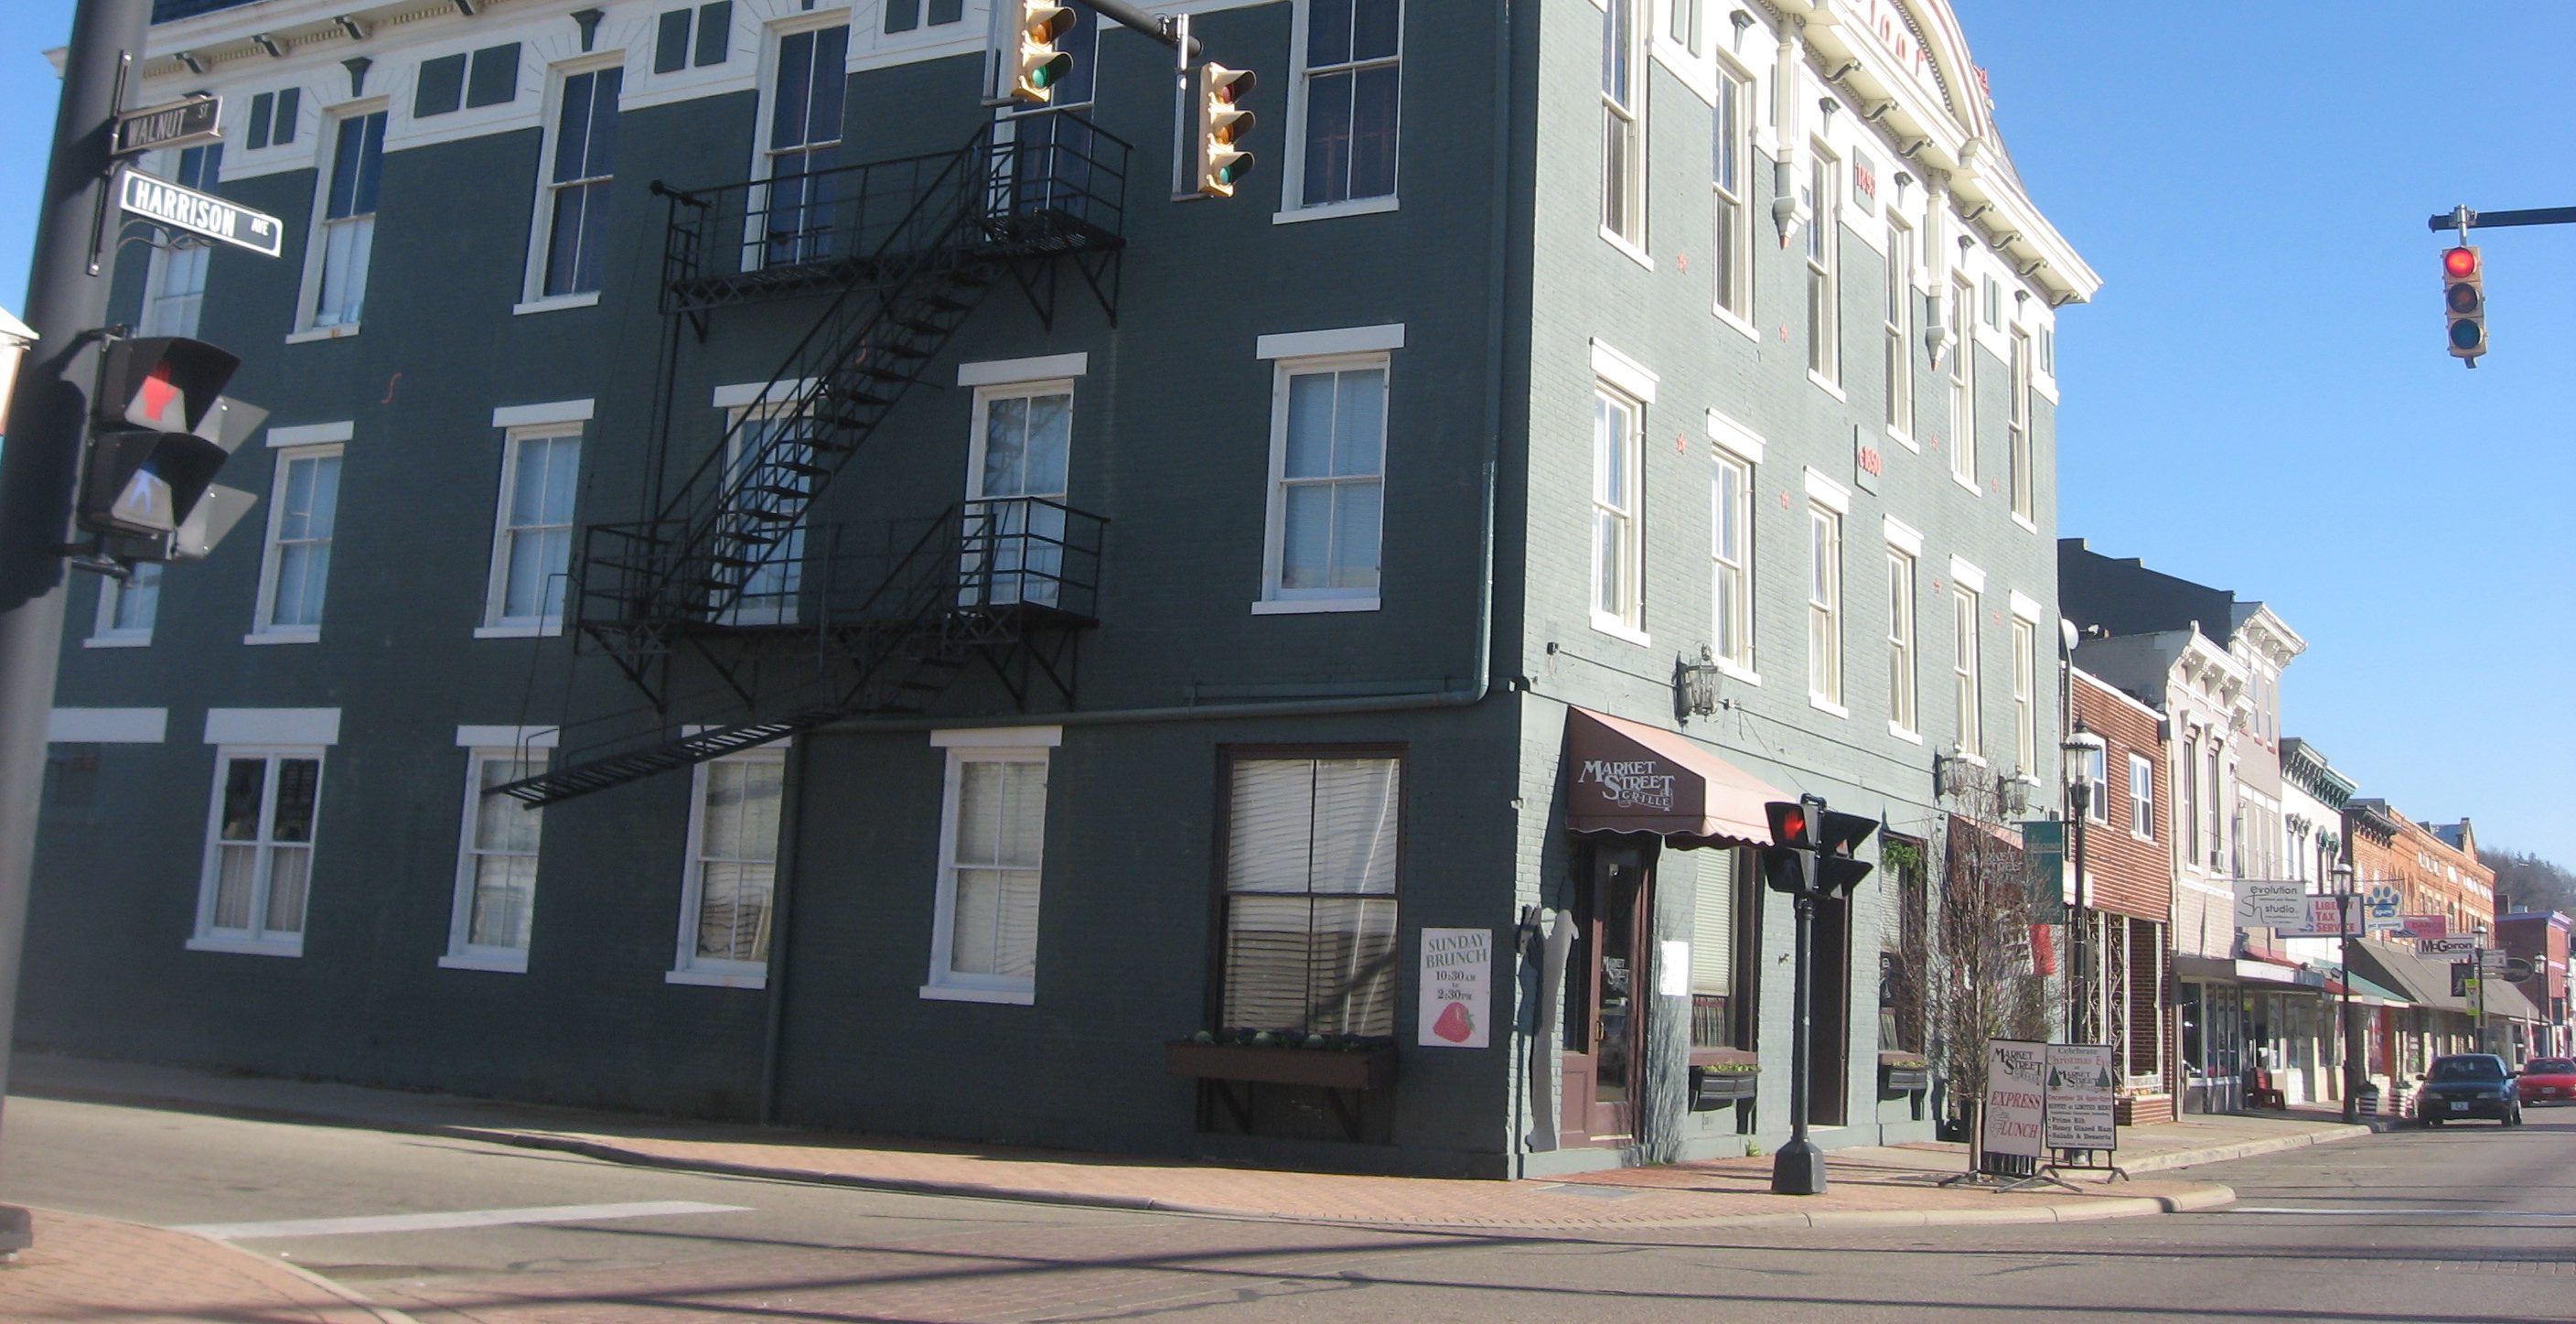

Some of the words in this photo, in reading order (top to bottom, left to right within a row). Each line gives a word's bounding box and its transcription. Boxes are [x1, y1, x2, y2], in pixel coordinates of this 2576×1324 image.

[128, 109, 187, 147] WALNUT
[199, 102, 209, 119] ST
[134, 180, 236, 237] HARRISON
[251, 218, 270, 236] AVE
[1578, 760, 1657, 783] MARKET
[1602, 775, 1675, 800] STREET
[1622, 790, 1670, 806] GRILLE
[2250, 886, 2298, 894] evolution
[2265, 905, 2294, 913] studio
[2315, 900, 2356, 910] LIBEY
[2315, 911, 2334, 921] TAX
[2316, 922, 2356, 932] SERVE
[1429, 933, 1485, 953] SUNDAY
[1426, 950, 1487, 968] BRUNCH
[1436, 971, 1464, 981] 10:30
[1437, 989, 1461, 1000] 2:30
[1992, 1048, 2034, 1062] MARKET
[2004, 1059, 2043, 1075] STREET
[1991, 1091, 2042, 1109] EXPRESS
[2002, 1122, 2039, 1138] LUNCH
